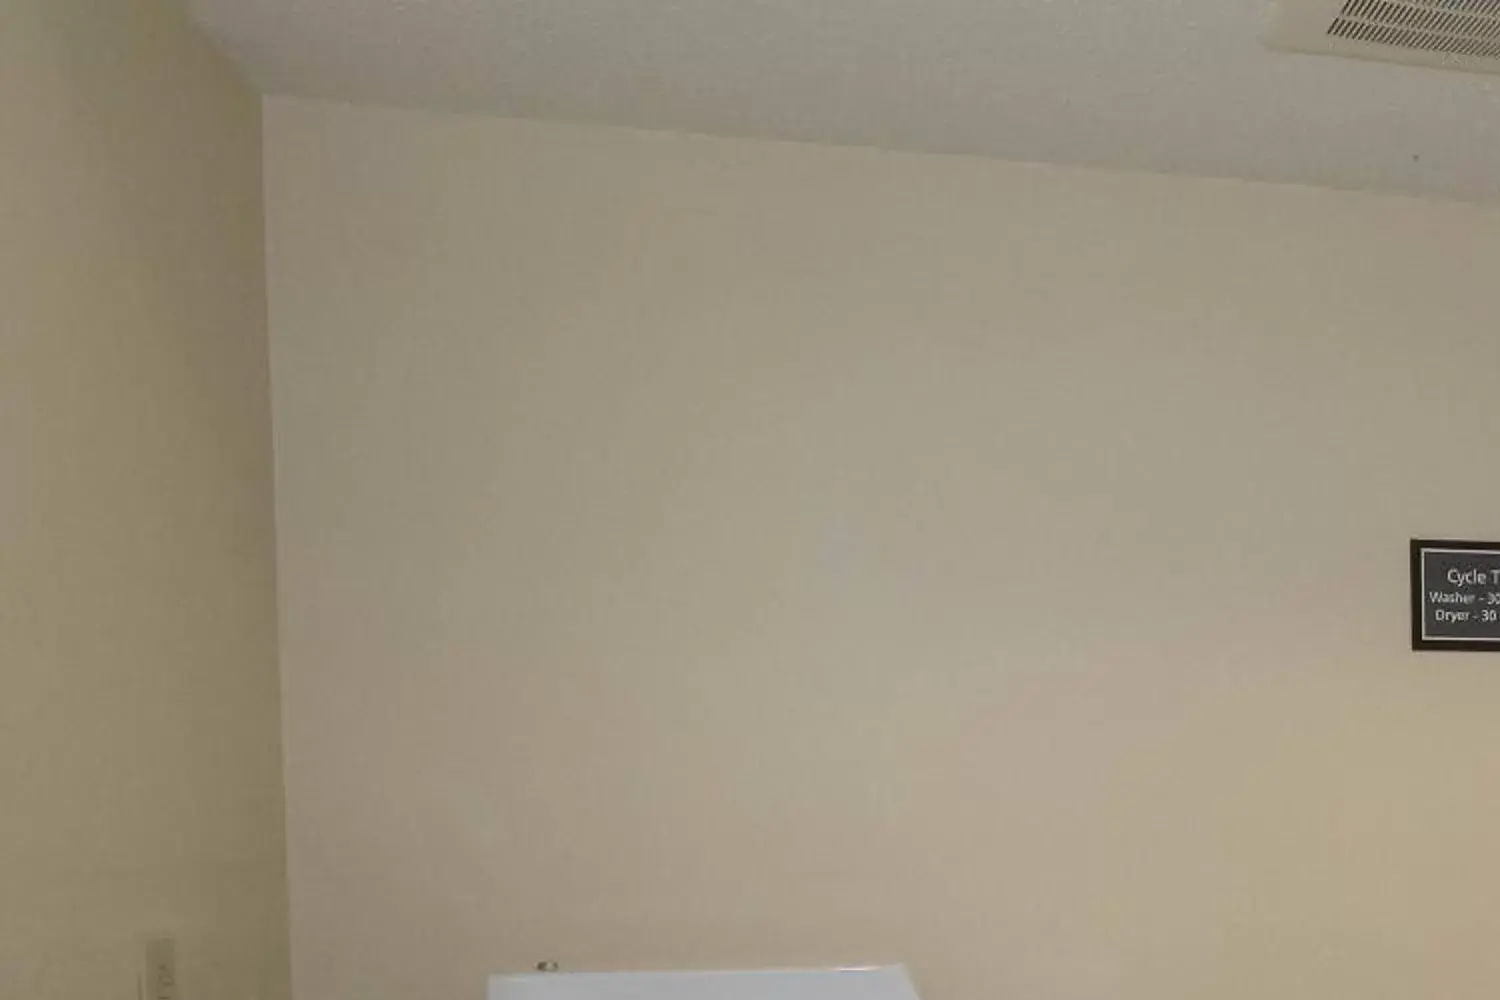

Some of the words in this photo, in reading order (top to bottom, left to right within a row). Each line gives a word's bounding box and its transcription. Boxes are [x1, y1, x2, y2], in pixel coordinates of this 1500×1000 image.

[1447, 567, 1487, 587] Cycle
[1429, 591, 1476, 605] Washer
[1435, 609, 1470, 623] Dryer
[1481, 609, 1497, 622] 30
